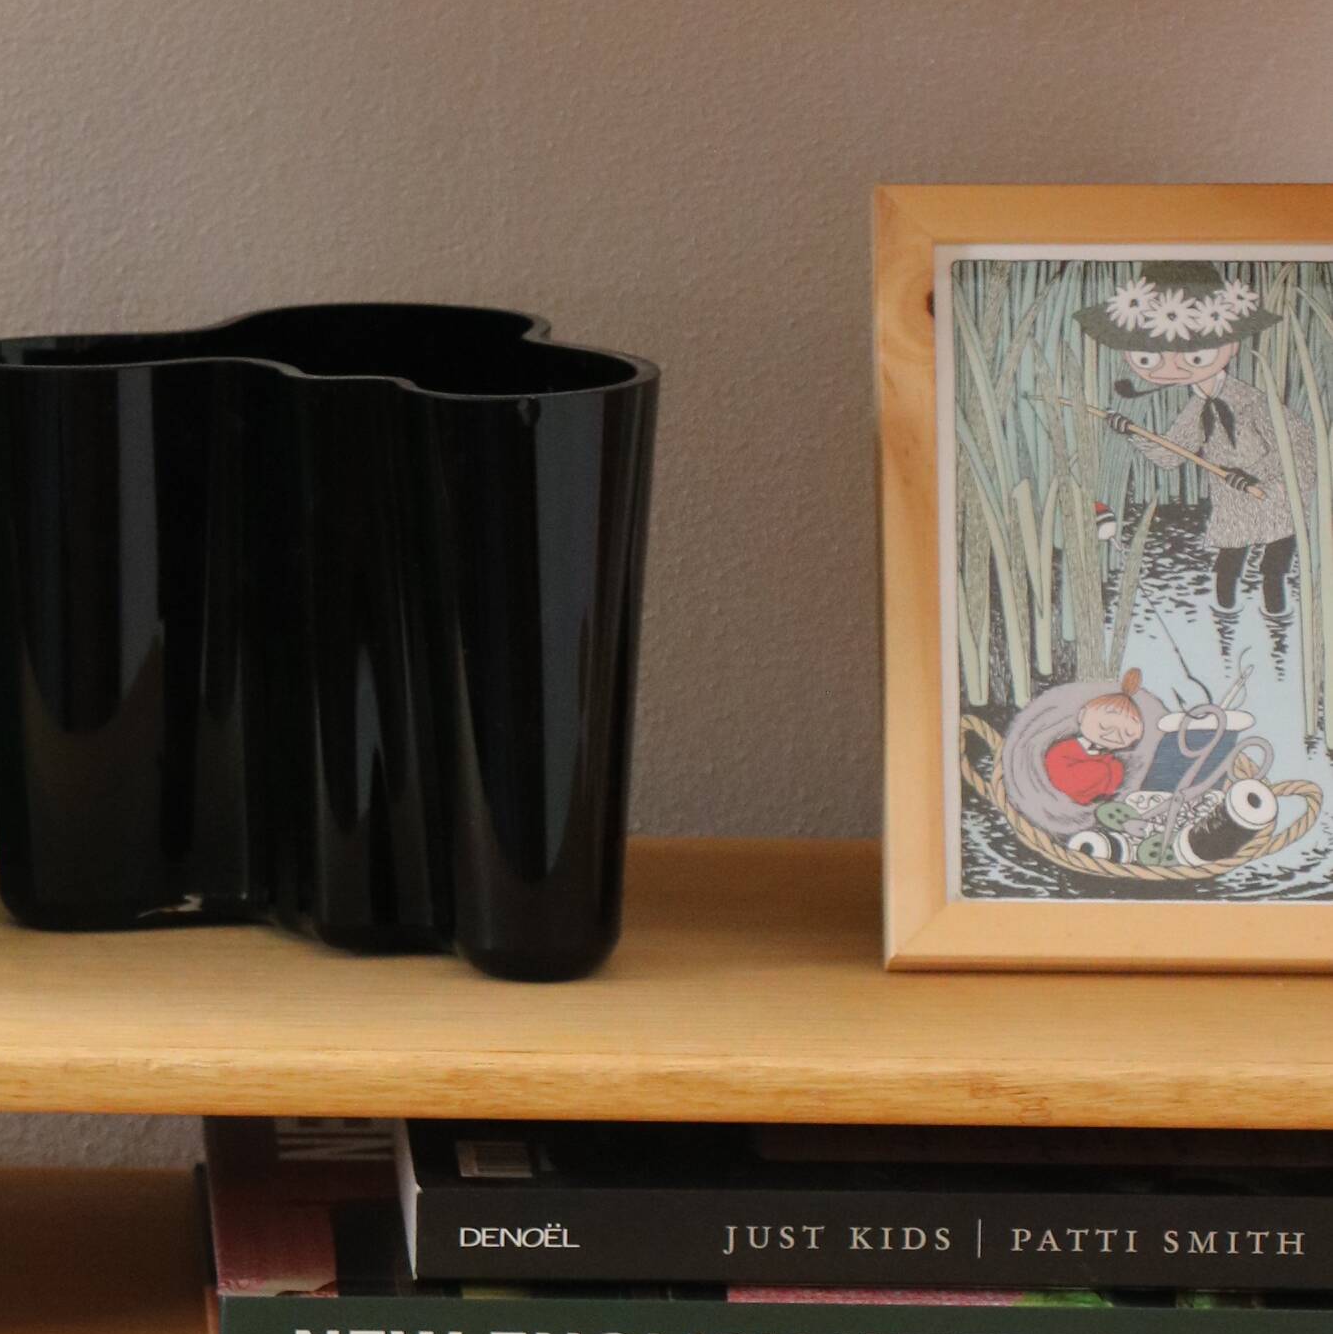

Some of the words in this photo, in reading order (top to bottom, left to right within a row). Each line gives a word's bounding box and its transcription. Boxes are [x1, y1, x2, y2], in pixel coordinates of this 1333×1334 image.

[460, 1223, 580, 1247] DENOËL
[723, 1226, 824, 1254] JUST
[850, 1227, 950, 1250] KIDS
[1011, 1229, 1137, 1252] PATTI
[1164, 1231, 1304, 1254] SMITH
